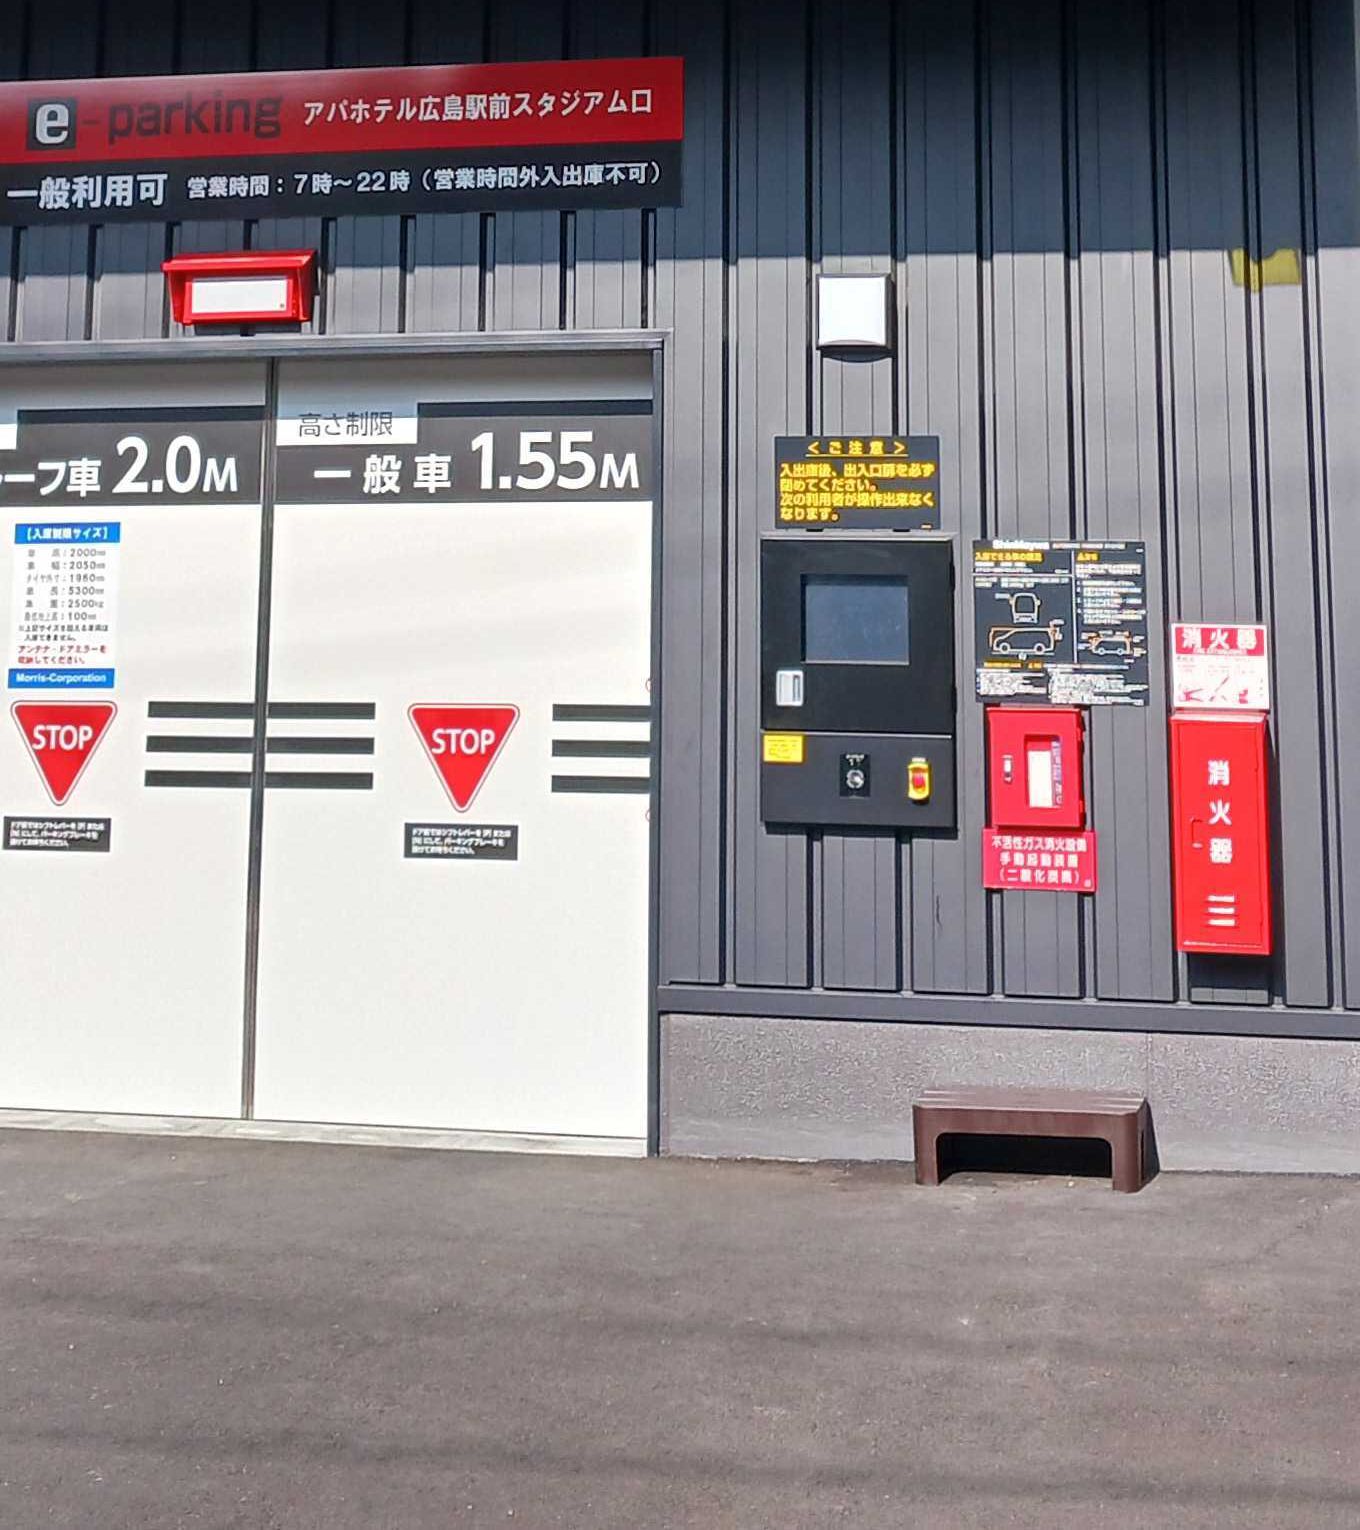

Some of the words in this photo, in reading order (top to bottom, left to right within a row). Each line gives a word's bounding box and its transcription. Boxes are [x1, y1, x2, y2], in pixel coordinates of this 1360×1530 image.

[303, 88, 652, 126] アパホテル広島駅前スタジアム口
[6, 173, 169, 210] 一般利用可
[298, 411, 393, 437] 高さ制限
[111, 435, 238, 495] 2.0M
[471, 430, 640, 491] 1.55M
[1181, 627, 1258, 650] 消火器
[32, 724, 93, 750] STOP
[432, 728, 495, 755] STOP
[1207, 759, 1233, 864] 消火器
